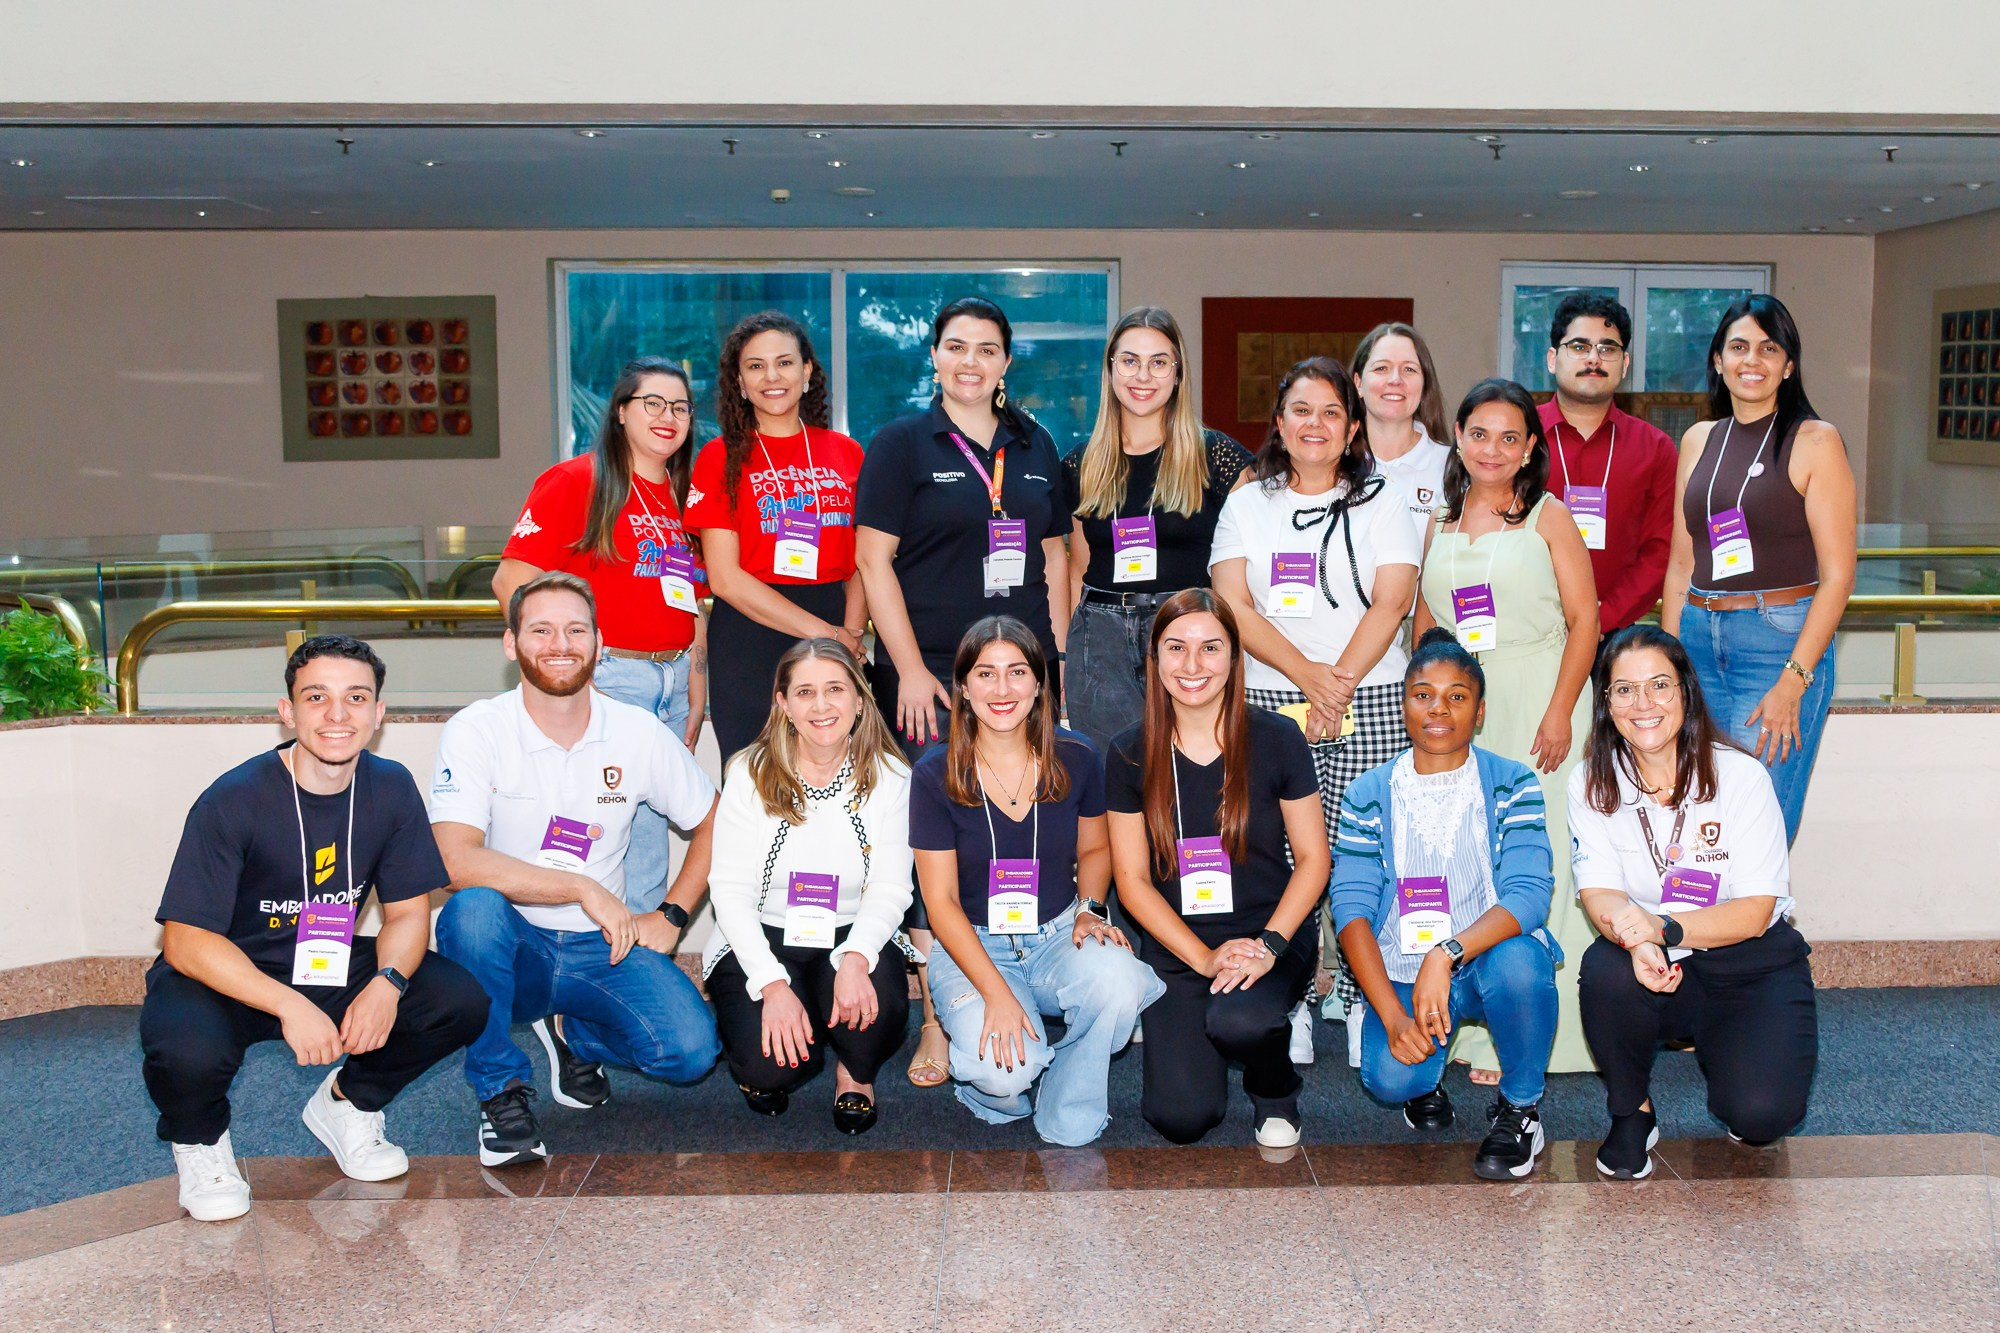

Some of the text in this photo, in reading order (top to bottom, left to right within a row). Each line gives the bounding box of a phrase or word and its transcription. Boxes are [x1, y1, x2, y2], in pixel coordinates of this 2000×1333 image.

[749, 465, 843, 484] DOCÊNCIA
[932, 471, 966, 479] POSITIVO
[752, 480, 788, 497] POR
[821, 494, 852, 508] PELA
[1409, 506, 1432, 515] DEHO
[628, 514, 683, 530] DOCÊN
[760, 512, 853, 534] PAIX NSINAR
[633, 562, 661, 577] PAIX
[597, 796, 628, 804] DEHON
[1188, 861, 1223, 869] PARTICIPANTE
[260, 880, 366, 914] EMBAADORE
[796, 896, 831, 904] PARTICIPANTE
[1671, 892, 1708, 902] PARTICIPANTE
[307, 929, 345, 937] PARTICIPANTE
